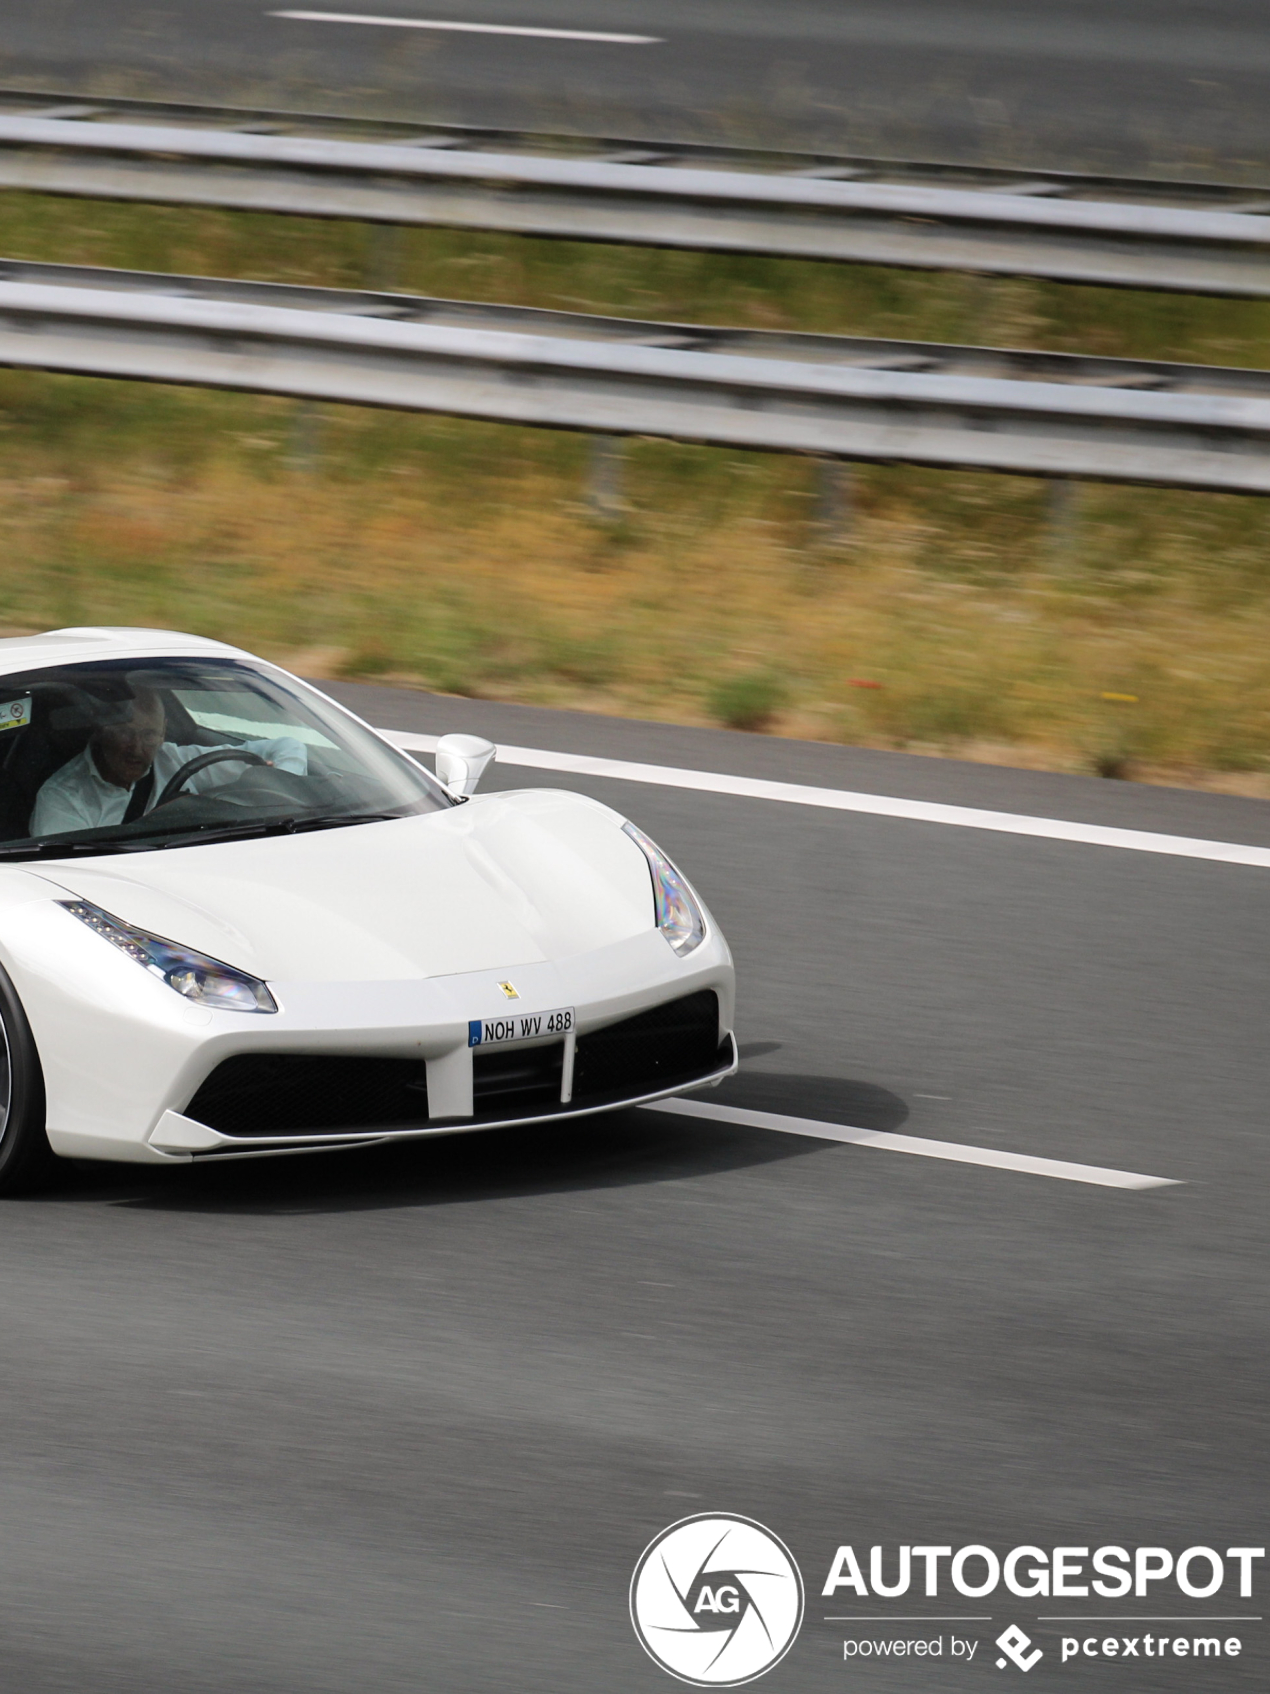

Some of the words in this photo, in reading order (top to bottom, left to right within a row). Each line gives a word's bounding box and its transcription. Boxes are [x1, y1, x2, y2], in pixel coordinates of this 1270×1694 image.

[472, 1036, 479, 1044] D
[484, 1020, 515, 1042] NOH
[521, 1016, 542, 1037] WV
[547, 1011, 572, 1032] 488
